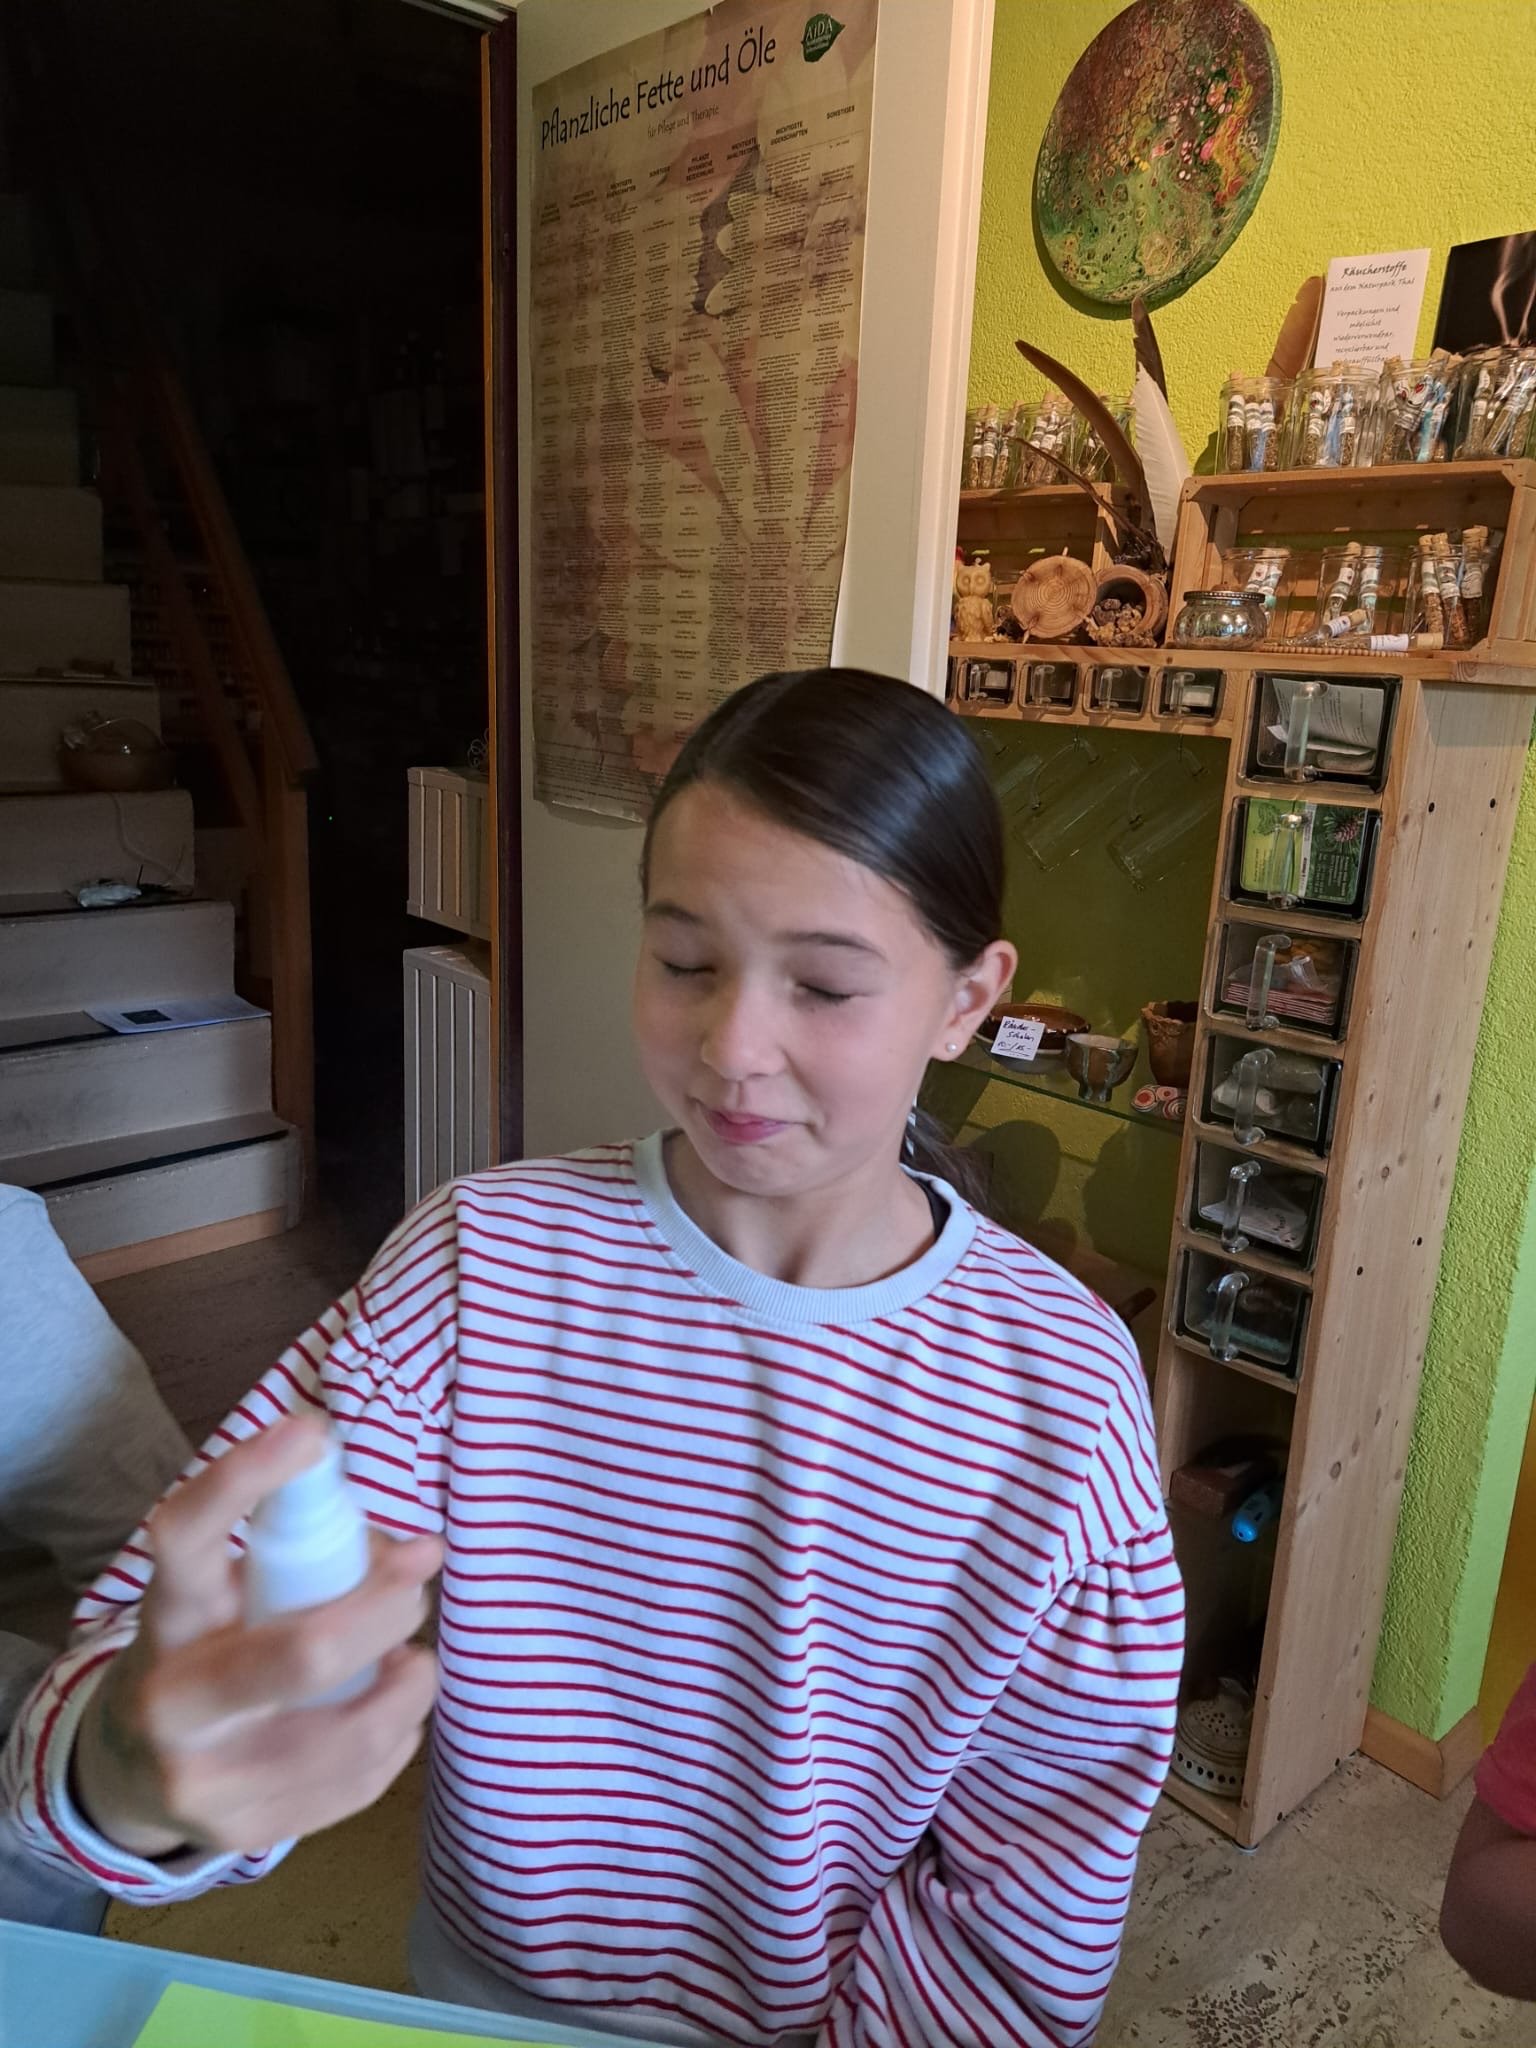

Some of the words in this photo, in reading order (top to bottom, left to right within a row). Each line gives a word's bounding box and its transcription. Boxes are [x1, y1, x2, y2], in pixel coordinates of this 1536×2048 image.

[541, 87, 630, 150] Pflanzliche
[636, 70, 684, 114] Fette
[690, 43, 729, 92] und
[737, 25, 776, 74] Öle
[657, 118, 677, 135] Pflege
[677, 113, 690, 128] und
[691, 103, 720, 121] Therapie
[1341, 260, 1407, 279] Räucherstoffe
[1343, 283, 1357, 291] dem
[1358, 280, 1395, 290] Naturpark
[1398, 277, 1415, 285] Thal
